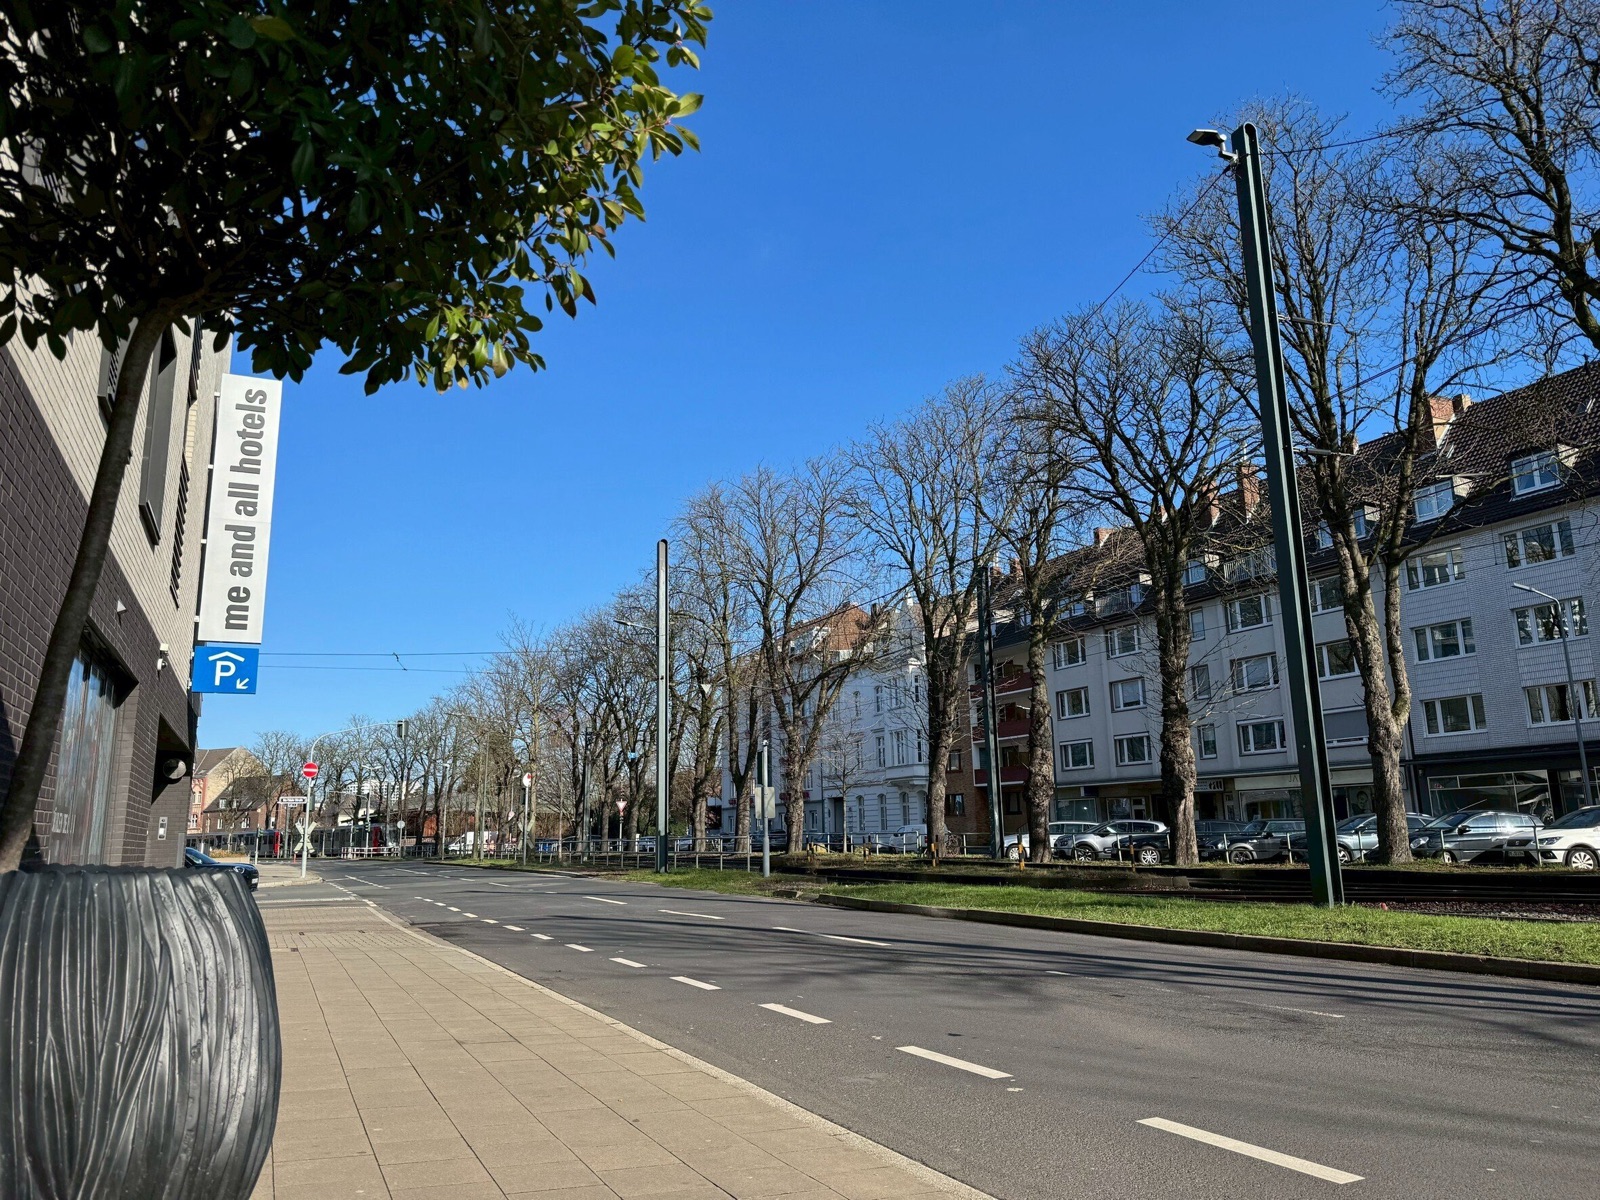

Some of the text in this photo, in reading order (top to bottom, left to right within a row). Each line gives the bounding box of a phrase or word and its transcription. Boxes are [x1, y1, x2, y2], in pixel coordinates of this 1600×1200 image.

[224, 388, 268, 631] me and all hotels
[214, 660, 236, 686] P
